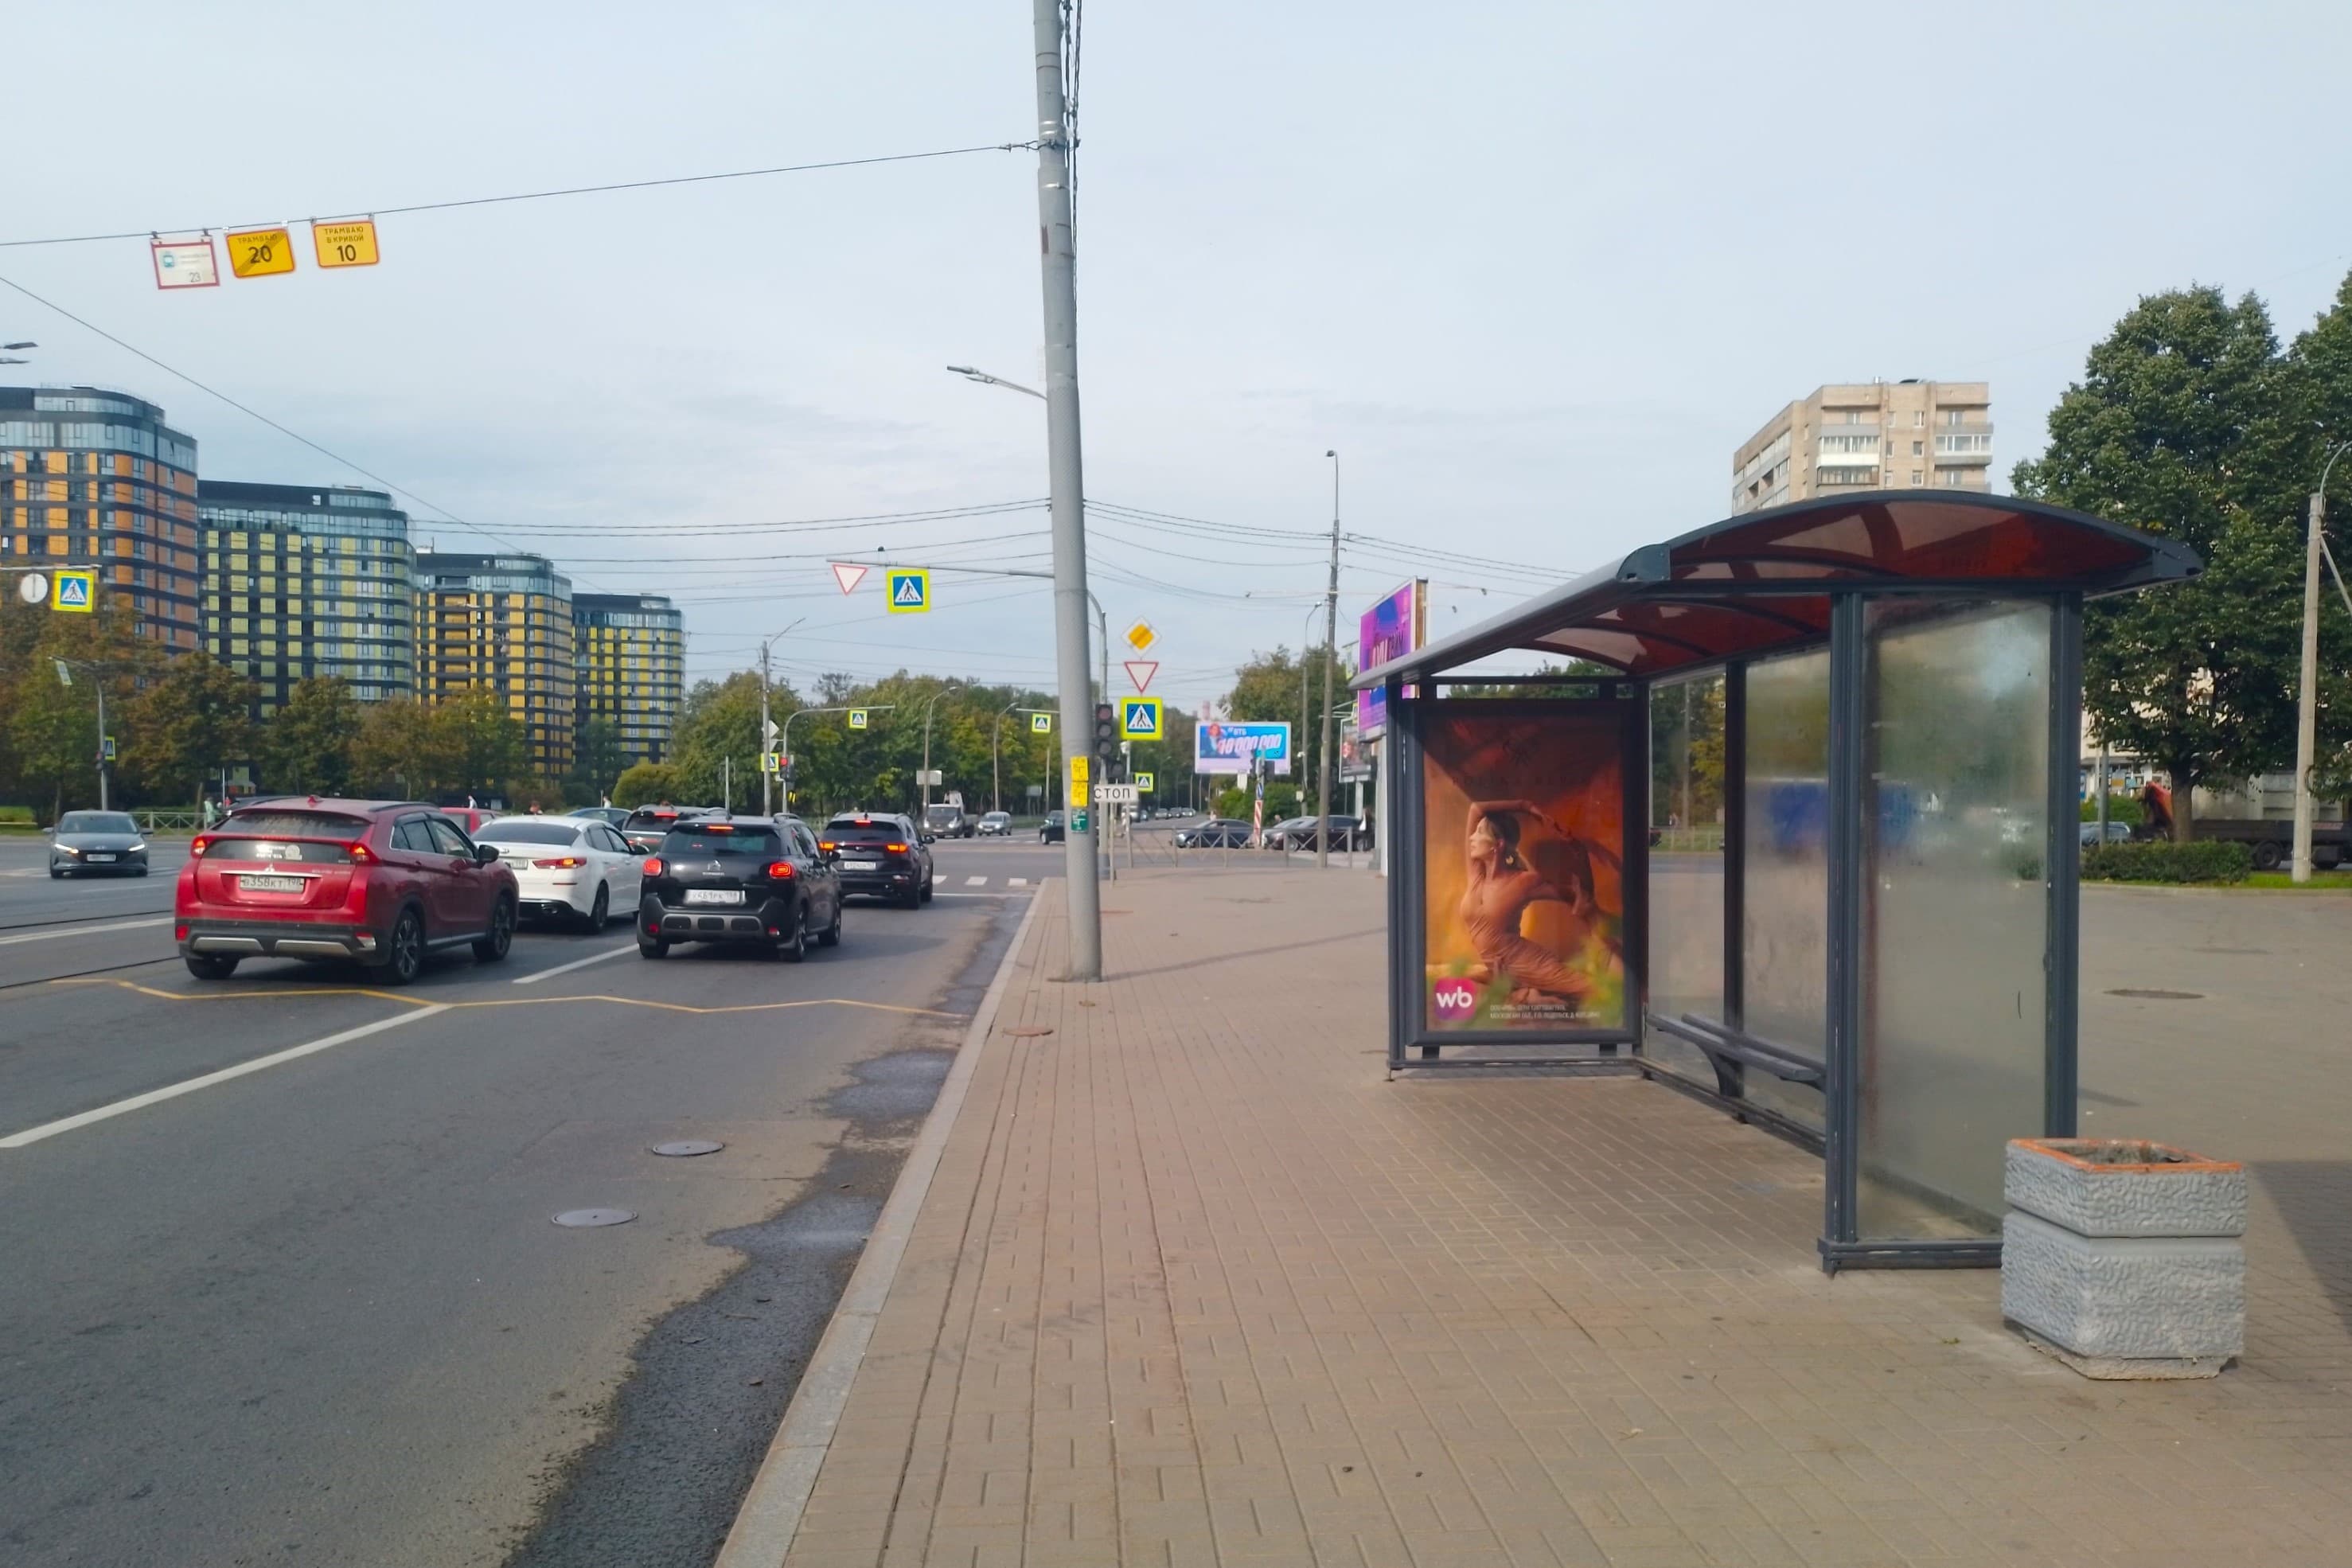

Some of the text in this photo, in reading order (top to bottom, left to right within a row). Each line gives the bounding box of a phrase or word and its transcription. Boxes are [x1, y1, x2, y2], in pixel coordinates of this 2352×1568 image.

[325, 226, 364, 235] ТРАМВАЮ
[248, 244, 272, 263] 20
[337, 244, 357, 262] 10
[1094, 788, 1130, 799] СТОП
[1436, 986, 1472, 1008] wb
